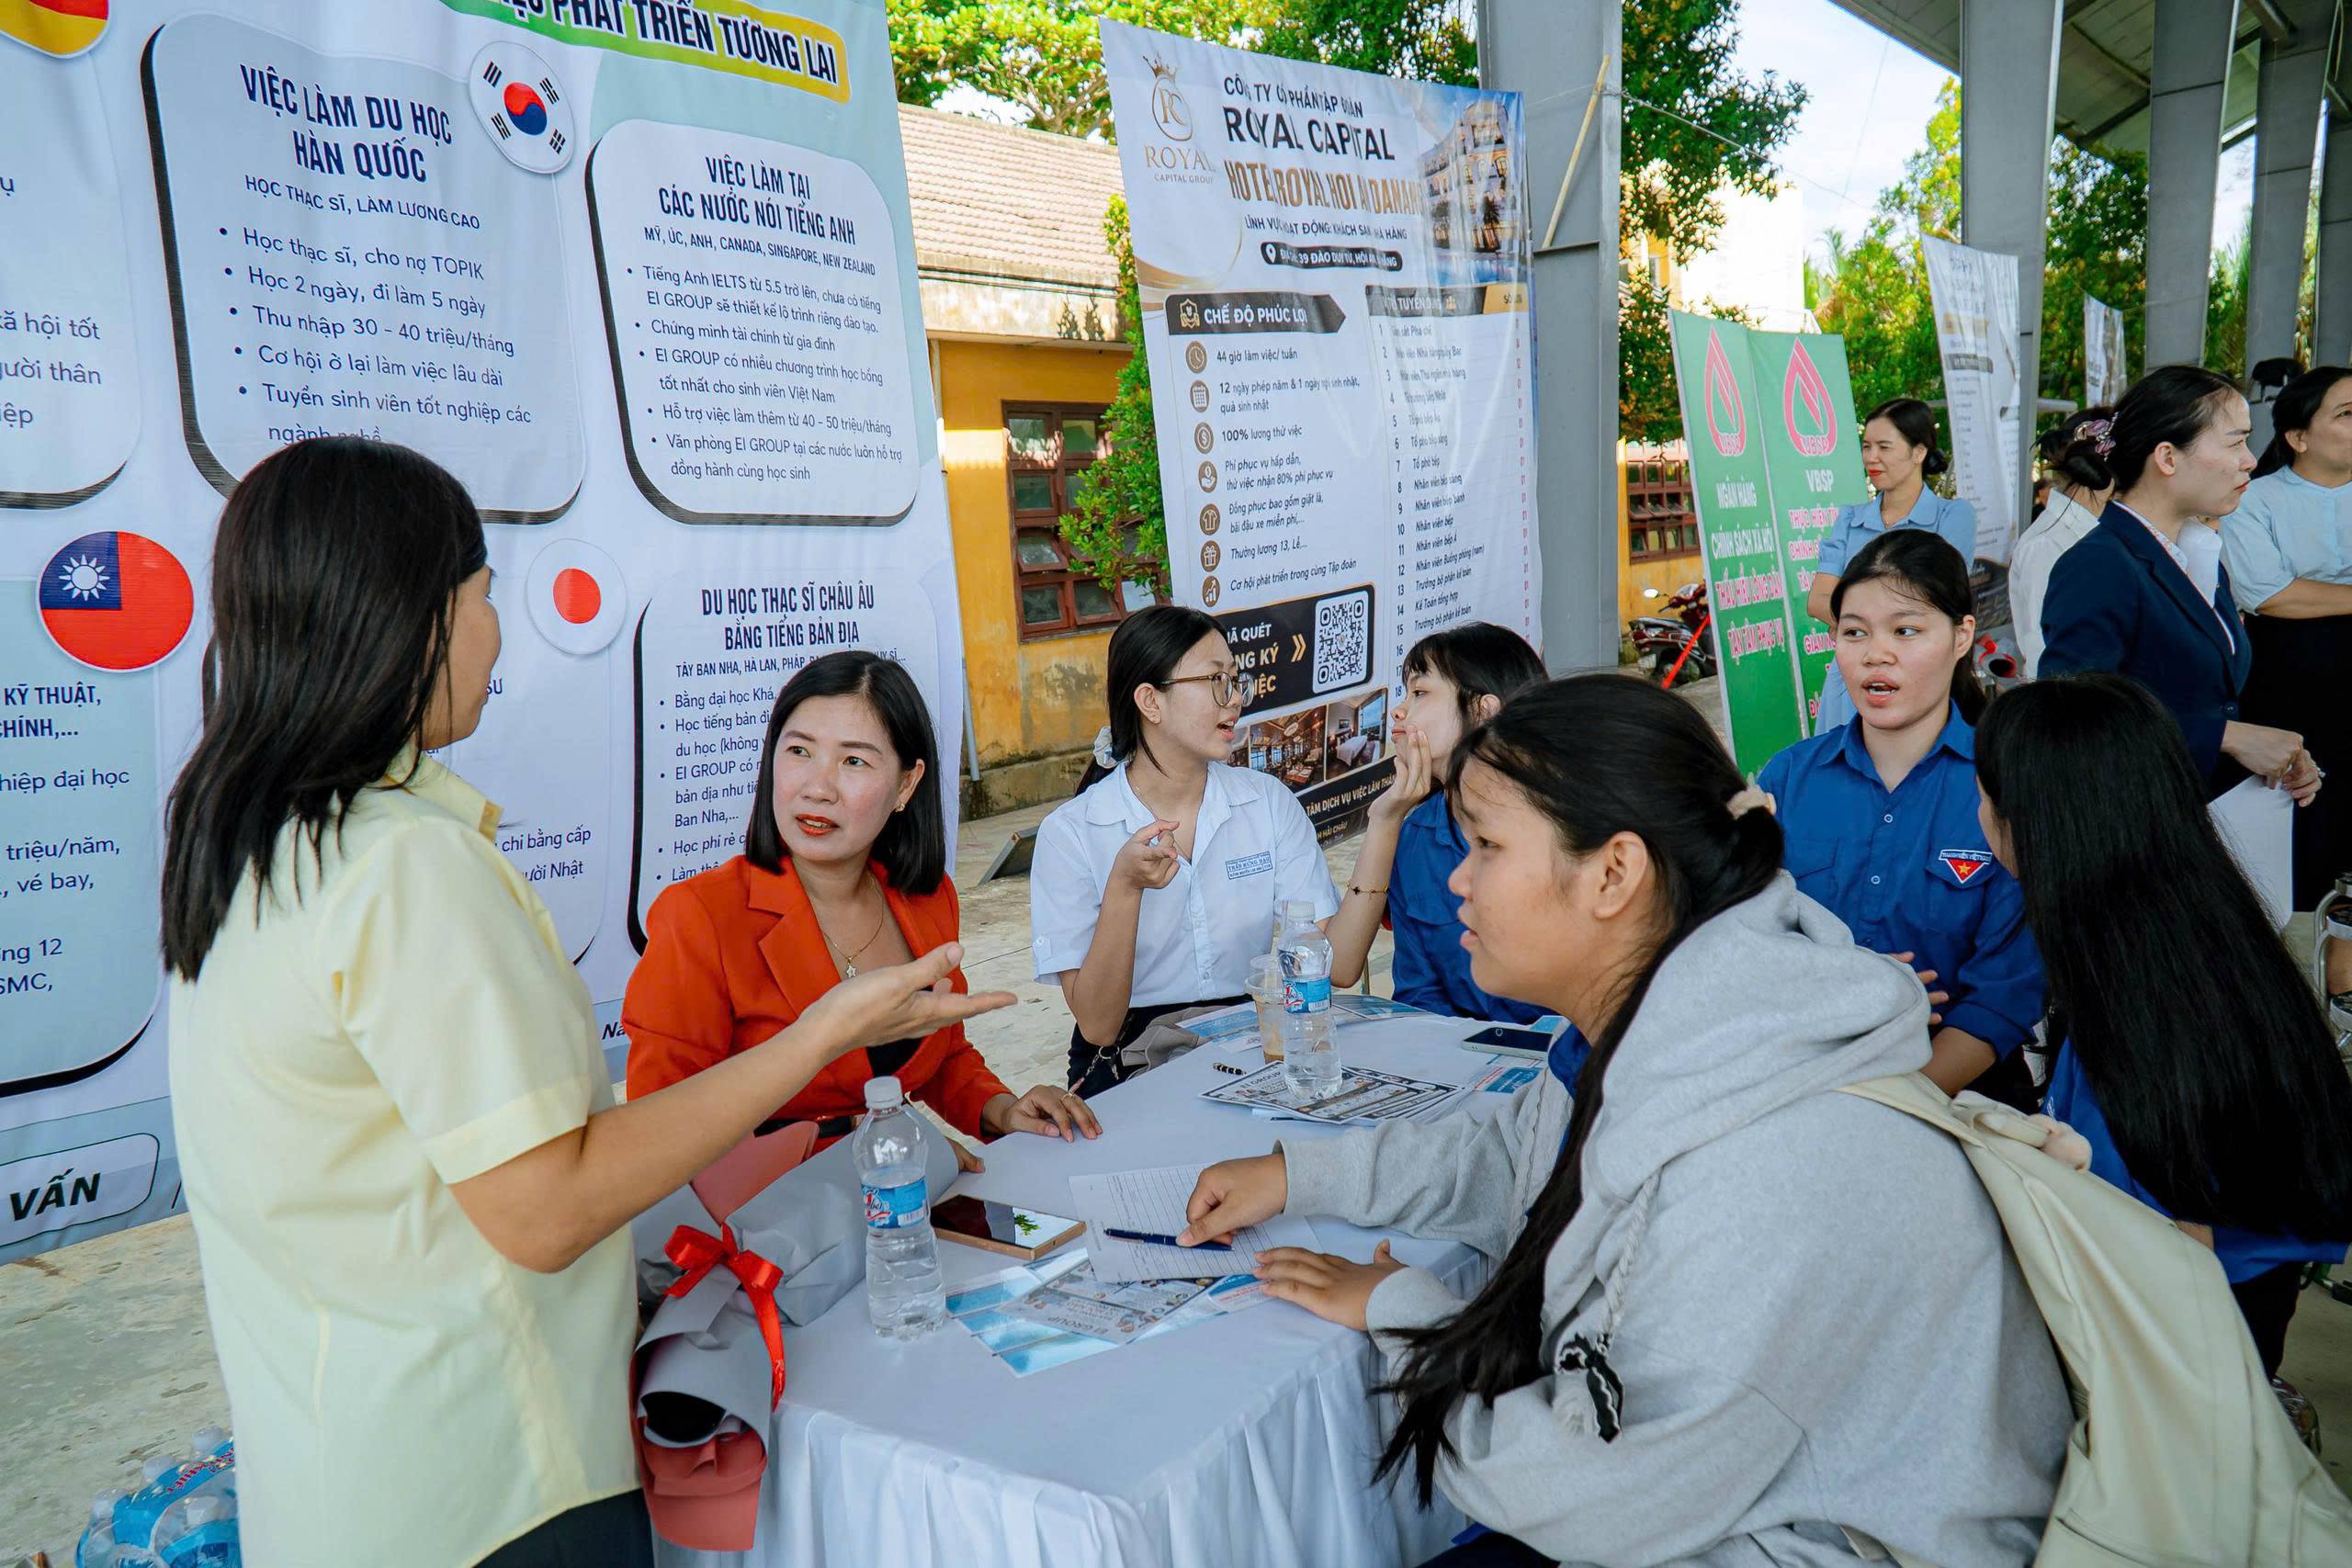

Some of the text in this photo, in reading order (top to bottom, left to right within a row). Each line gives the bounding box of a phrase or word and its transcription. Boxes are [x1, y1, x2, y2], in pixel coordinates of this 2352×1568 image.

[718, 17, 836, 84] TƯƠNG LAI
[240, 64, 451, 146] VIỆC LÀM DU HỌC
[1254, 85, 1271, 102] TY
[1308, 119, 1395, 160] CAPITAL
[293, 130, 426, 182] HÀN QUỐC
[1146, 146, 1216, 173] ROYAL
[706, 154, 810, 199] VIỆC LÀM TẠI
[1155, 174, 1187, 183] CAPITAL
[245, 175, 480, 229] HỌC THẠC SĨ, LÀM LƯƠNG CAO
[659, 184, 855, 244] CÁC NƯỚC NÓI TIẾNG ANH
[243, 227, 483, 279] Học thạc sĩ, cho nợ TOPIK
[645, 226, 875, 276] MỸ, ÚC, ANH, CANADA, SINGAPORE, NEW ZEALAND
[249, 265, 485, 318] Học 2 ngày, đi làm 5 ngày
[25, 312, 100, 339] hội tốt
[1204, 303, 1307, 327] CHẾ ĐỘ PHÚC LỢI
[253, 305, 514, 357] Thu nhập 30 40 triệu/tháng
[259, 345, 503, 386] Cơ hội lại làm việc lâu dài
[1217, 351, 1227, 362] 44
[1229, 351, 1241, 365] giờ
[1245, 350, 1259, 361] làm
[50, 362, 101, 384] thân
[660, 375, 835, 402] tốt nhất cho sinh viên Việt Nam
[262, 383, 530, 424] Tuyển sinh viên tốt nghiệp các
[663, 402, 891, 437] Hỗ trợ việc làm thêm từ 40 50 triệu/tháng
[1223, 429, 1249, 441] 100%
[1251, 429, 1271, 441] lương
[1288, 424, 1302, 437] việc
[672, 458, 809, 481] đồng hành cùng học sinh
[1805, 469, 1833, 492] VBSP
[1398, 524, 1405, 535] 10
[1399, 545, 1404, 555] 11
[1398, 565, 1404, 576] 12
[1398, 584, 1404, 595] 13
[702, 581, 874, 623] DU HỌC THẠC SĨ CHÂU ÂU
[1397, 604, 1404, 615] 14
[725, 615, 859, 649] BẰNG TIẾNG BẢN ĐỊA
[1241, 622, 1272, 641] QUÉT
[1261, 642, 1278, 665] KÝ
[697, 663, 716, 675] BAN
[719, 661, 741, 675] NHA,
[744, 657, 757, 671] HÀ
[760, 659, 779, 672] LAN,
[5, 682, 100, 707] KỸ THUẬT,
[675, 691, 749, 709] Bằng đại học
[54, 769, 129, 791] đại học
[676, 758, 752, 780] EI GROUP có
[1306, 799, 1320, 816] TÂM
[1322, 795, 1340, 811] DỊCH
[1341, 792, 1351, 805] VỤ
[527, 825, 591, 849] bằng cấp
[6, 837, 119, 863] triệu/năm,
[550, 860, 582, 878] Nhật
[17, 873, 93, 892] vé bay,
[40, 939, 62, 956] 12
[10, 1168, 100, 1221] VẤN
